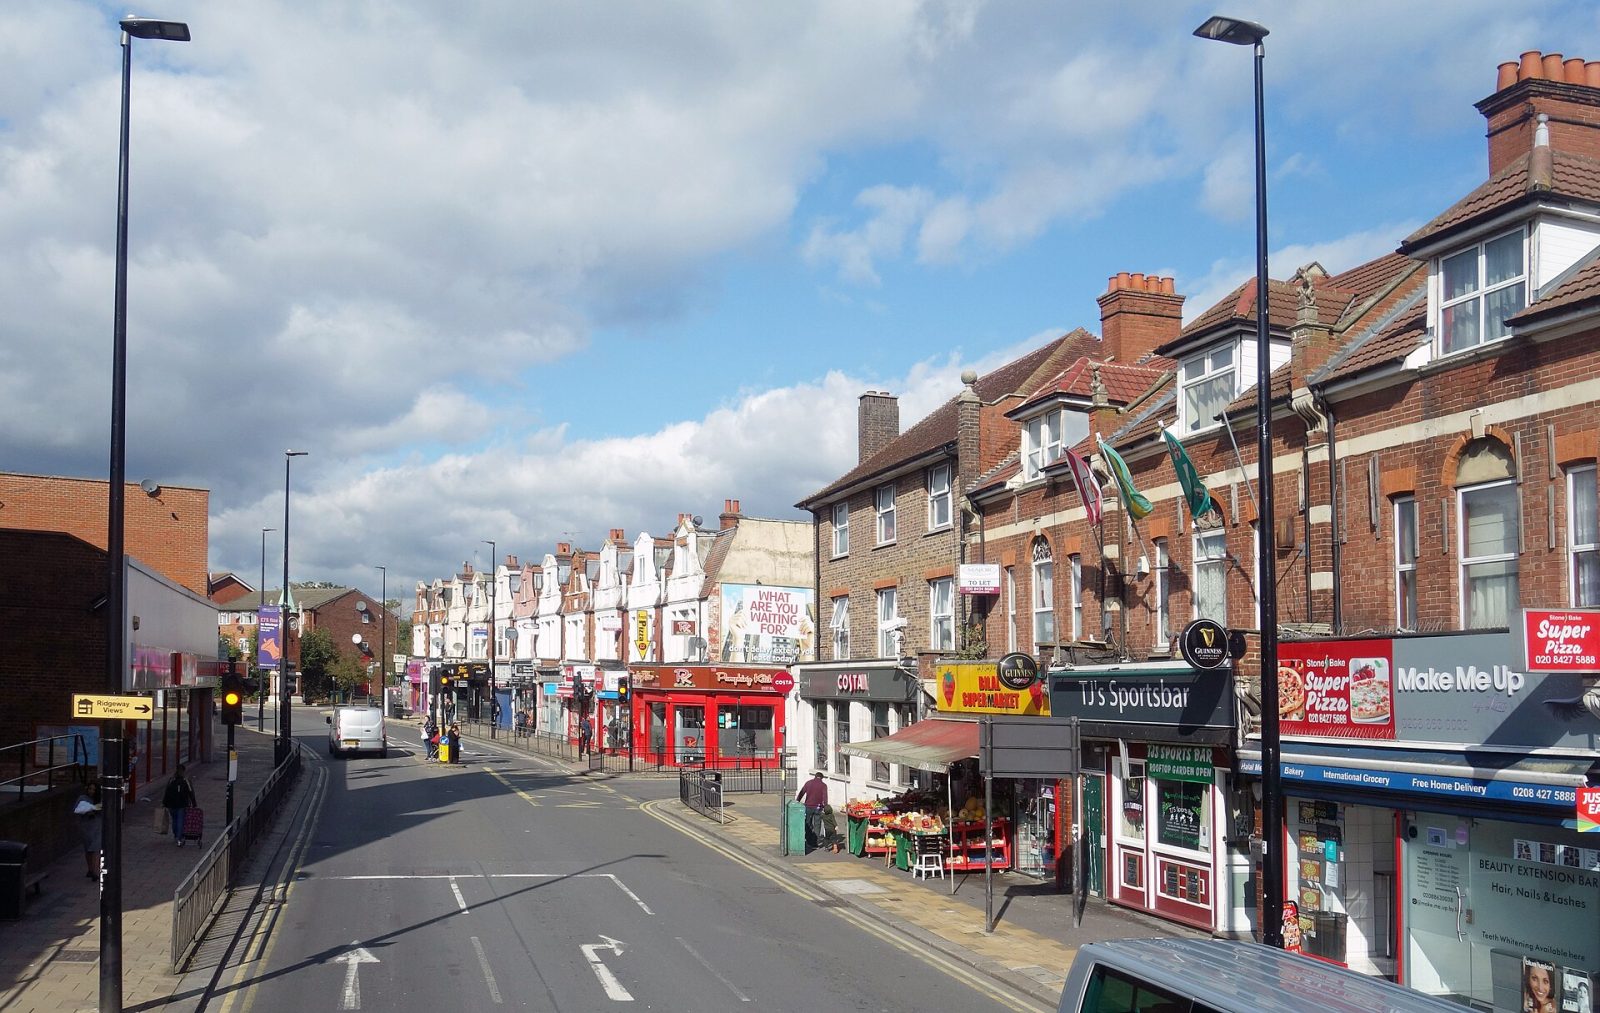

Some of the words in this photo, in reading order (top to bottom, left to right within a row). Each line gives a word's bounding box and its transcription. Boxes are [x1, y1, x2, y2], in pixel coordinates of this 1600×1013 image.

[759, 590, 791, 602] WHAT
[750, 601, 772, 612] ARE
[776, 603, 798, 614] YOU
[751, 612, 798, 625] WAITING
[639, 621, 648, 641] Pizza
[761, 623, 788, 635] FOR?
[1536, 619, 1591, 644] Super
[729, 645, 749, 653] don't
[774, 647, 800, 655] extend
[801, 648, 815, 657] you
[1194, 647, 1222, 655] GUINNESS
[1545, 640, 1583, 654] Pizza
[752, 654, 771, 662] lease
[772, 655, 796, 664] today!
[1306, 658, 1325, 668] Stone
[1329, 658, 1346, 667] Bake
[1535, 655, 1551, 664] 020
[1553, 655, 1573, 664] 8427
[1575, 655, 1596, 664] 5888
[754, 674, 773, 684] Kitch
[1005, 669, 1034, 679] GUINNESS
[1398, 667, 1454, 692] Make
[1455, 665, 1492, 692] Me
[1493, 664, 1524, 697] Up
[837, 673, 868, 692] COSTA
[1303, 671, 1350, 697] Super
[962, 691, 1020, 709] SUPERMARKET
[1078, 680, 1106, 707] TJ's
[1108, 679, 1191, 713] Sportsbar
[1305, 691, 1349, 711] Pizza
[96, 700, 130, 709] Ridgeway
[1308, 713, 1318, 723] 020
[1319, 713, 1332, 723] 8427
[1333, 714, 1347, 724] 5888
[1160, 746, 1192, 761] SPORTS
[1194, 748, 1214, 764] BAR
[1149, 763, 1172, 774] ROOFTOP
[1172, 765, 1195, 776] GARDEN
[1195, 767, 1212, 777] OPEN
[1284, 766, 1304, 778] Bakery
[1323, 769, 1361, 782] International
[1362, 774, 1390, 787] Grocery
[1412, 778, 1429, 788] Free
[1430, 780, 1453, 791] Home
[1454, 782, 1487, 796] Delivery
[1513, 786, 1534, 798] 0208
[1536, 788, 1552, 800] 427
[1554, 790, 1576, 802] 5888
[1582, 792, 1600, 804] JUS
[1587, 803, 1600, 815] EA
[1479, 859, 1514, 874] BEAUTY
[1517, 865, 1576, 885] EXTENSION
[1578, 875, 1600, 889] BAR
[1491, 882, 1513, 897] Hair,
[1516, 887, 1541, 901] Nails
[1543, 891, 1551, 901] &
[1552, 894, 1586, 909] Lashes
[1482, 931, 1499, 941] Teeth
[1499, 935, 1534, 951] Whitening
[1535, 944, 1568, 958] Available
[1569, 950, 1586, 962] here
